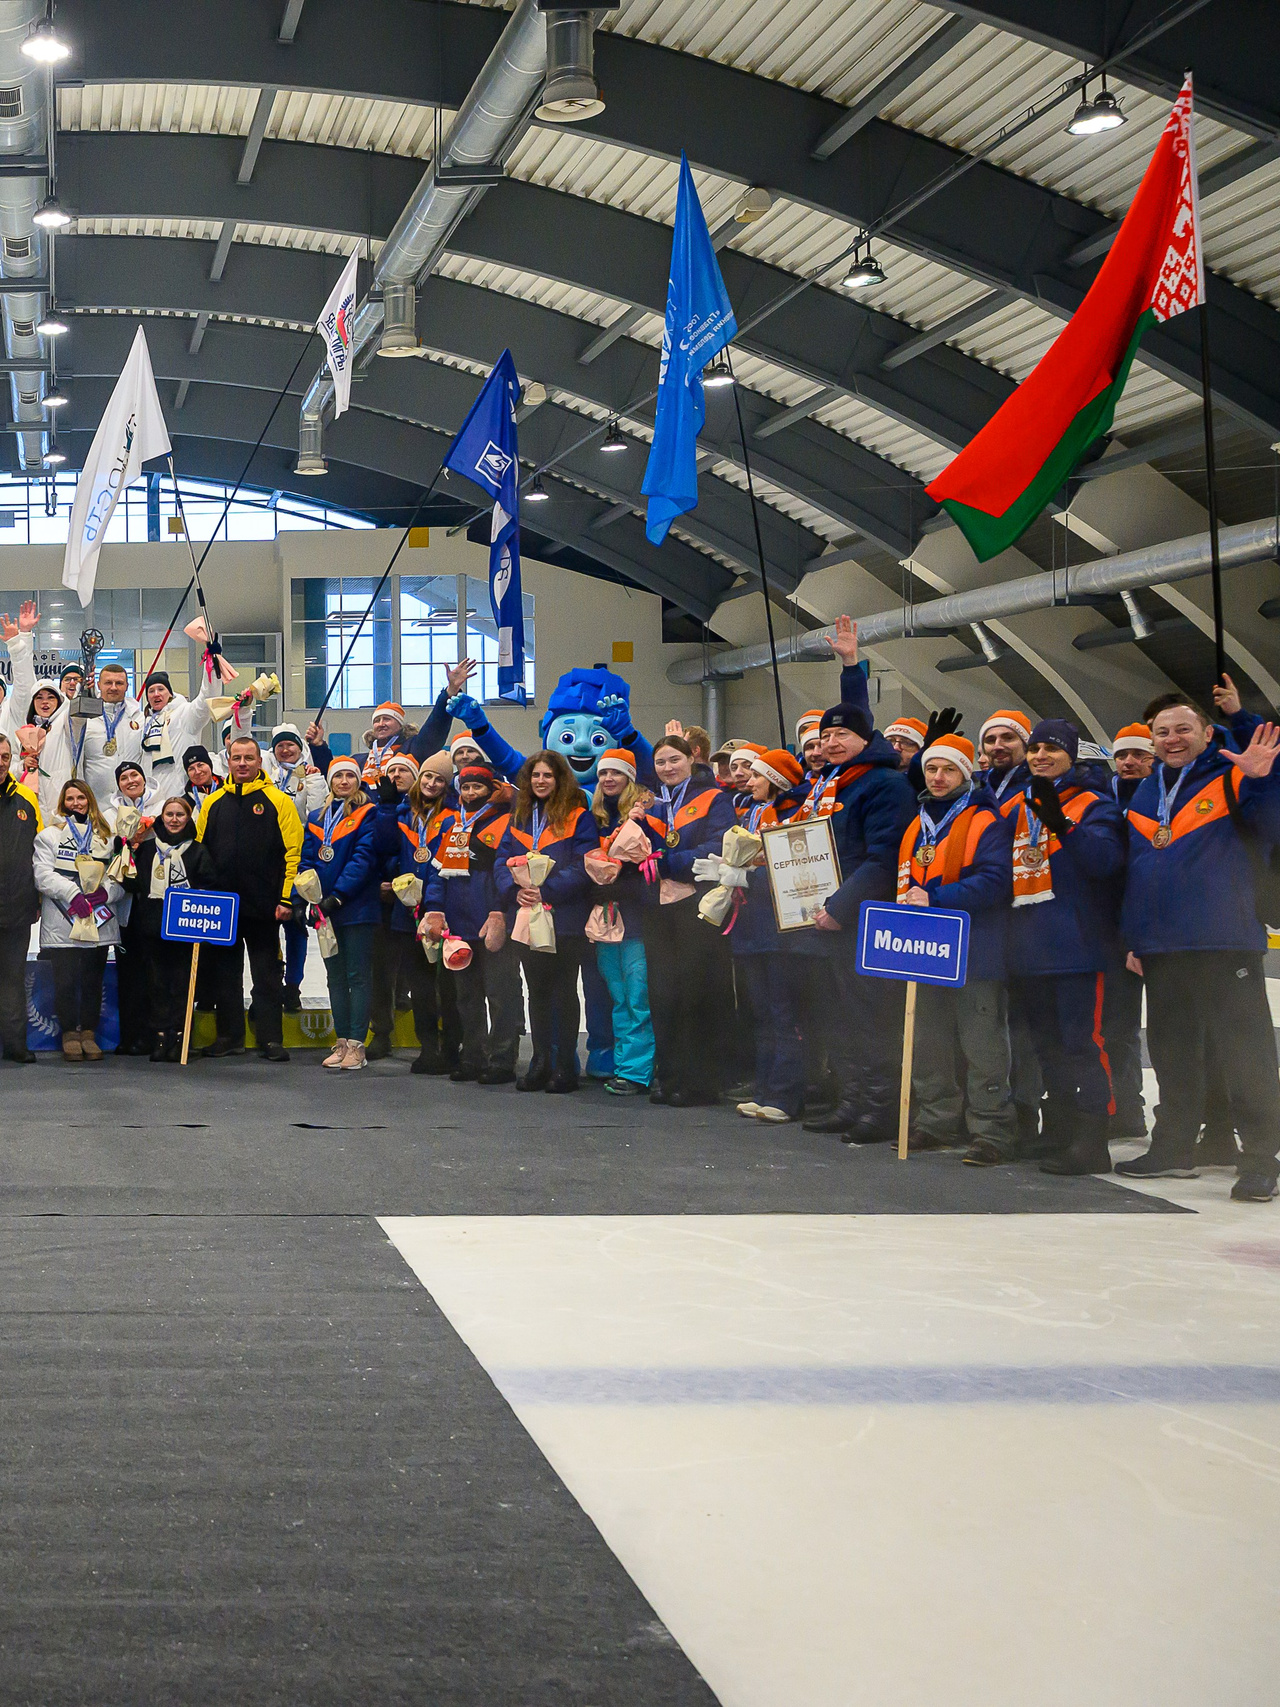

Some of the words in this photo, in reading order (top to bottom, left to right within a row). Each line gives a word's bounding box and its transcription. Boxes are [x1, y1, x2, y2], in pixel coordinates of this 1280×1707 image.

[33, 653, 56, 661] АФЕ
[773, 853, 830, 870] СЕРТИФИКАТ
[181, 899, 221, 916] Белые
[178, 917, 222, 933] тигры
[874, 930, 950, 959] Молния
